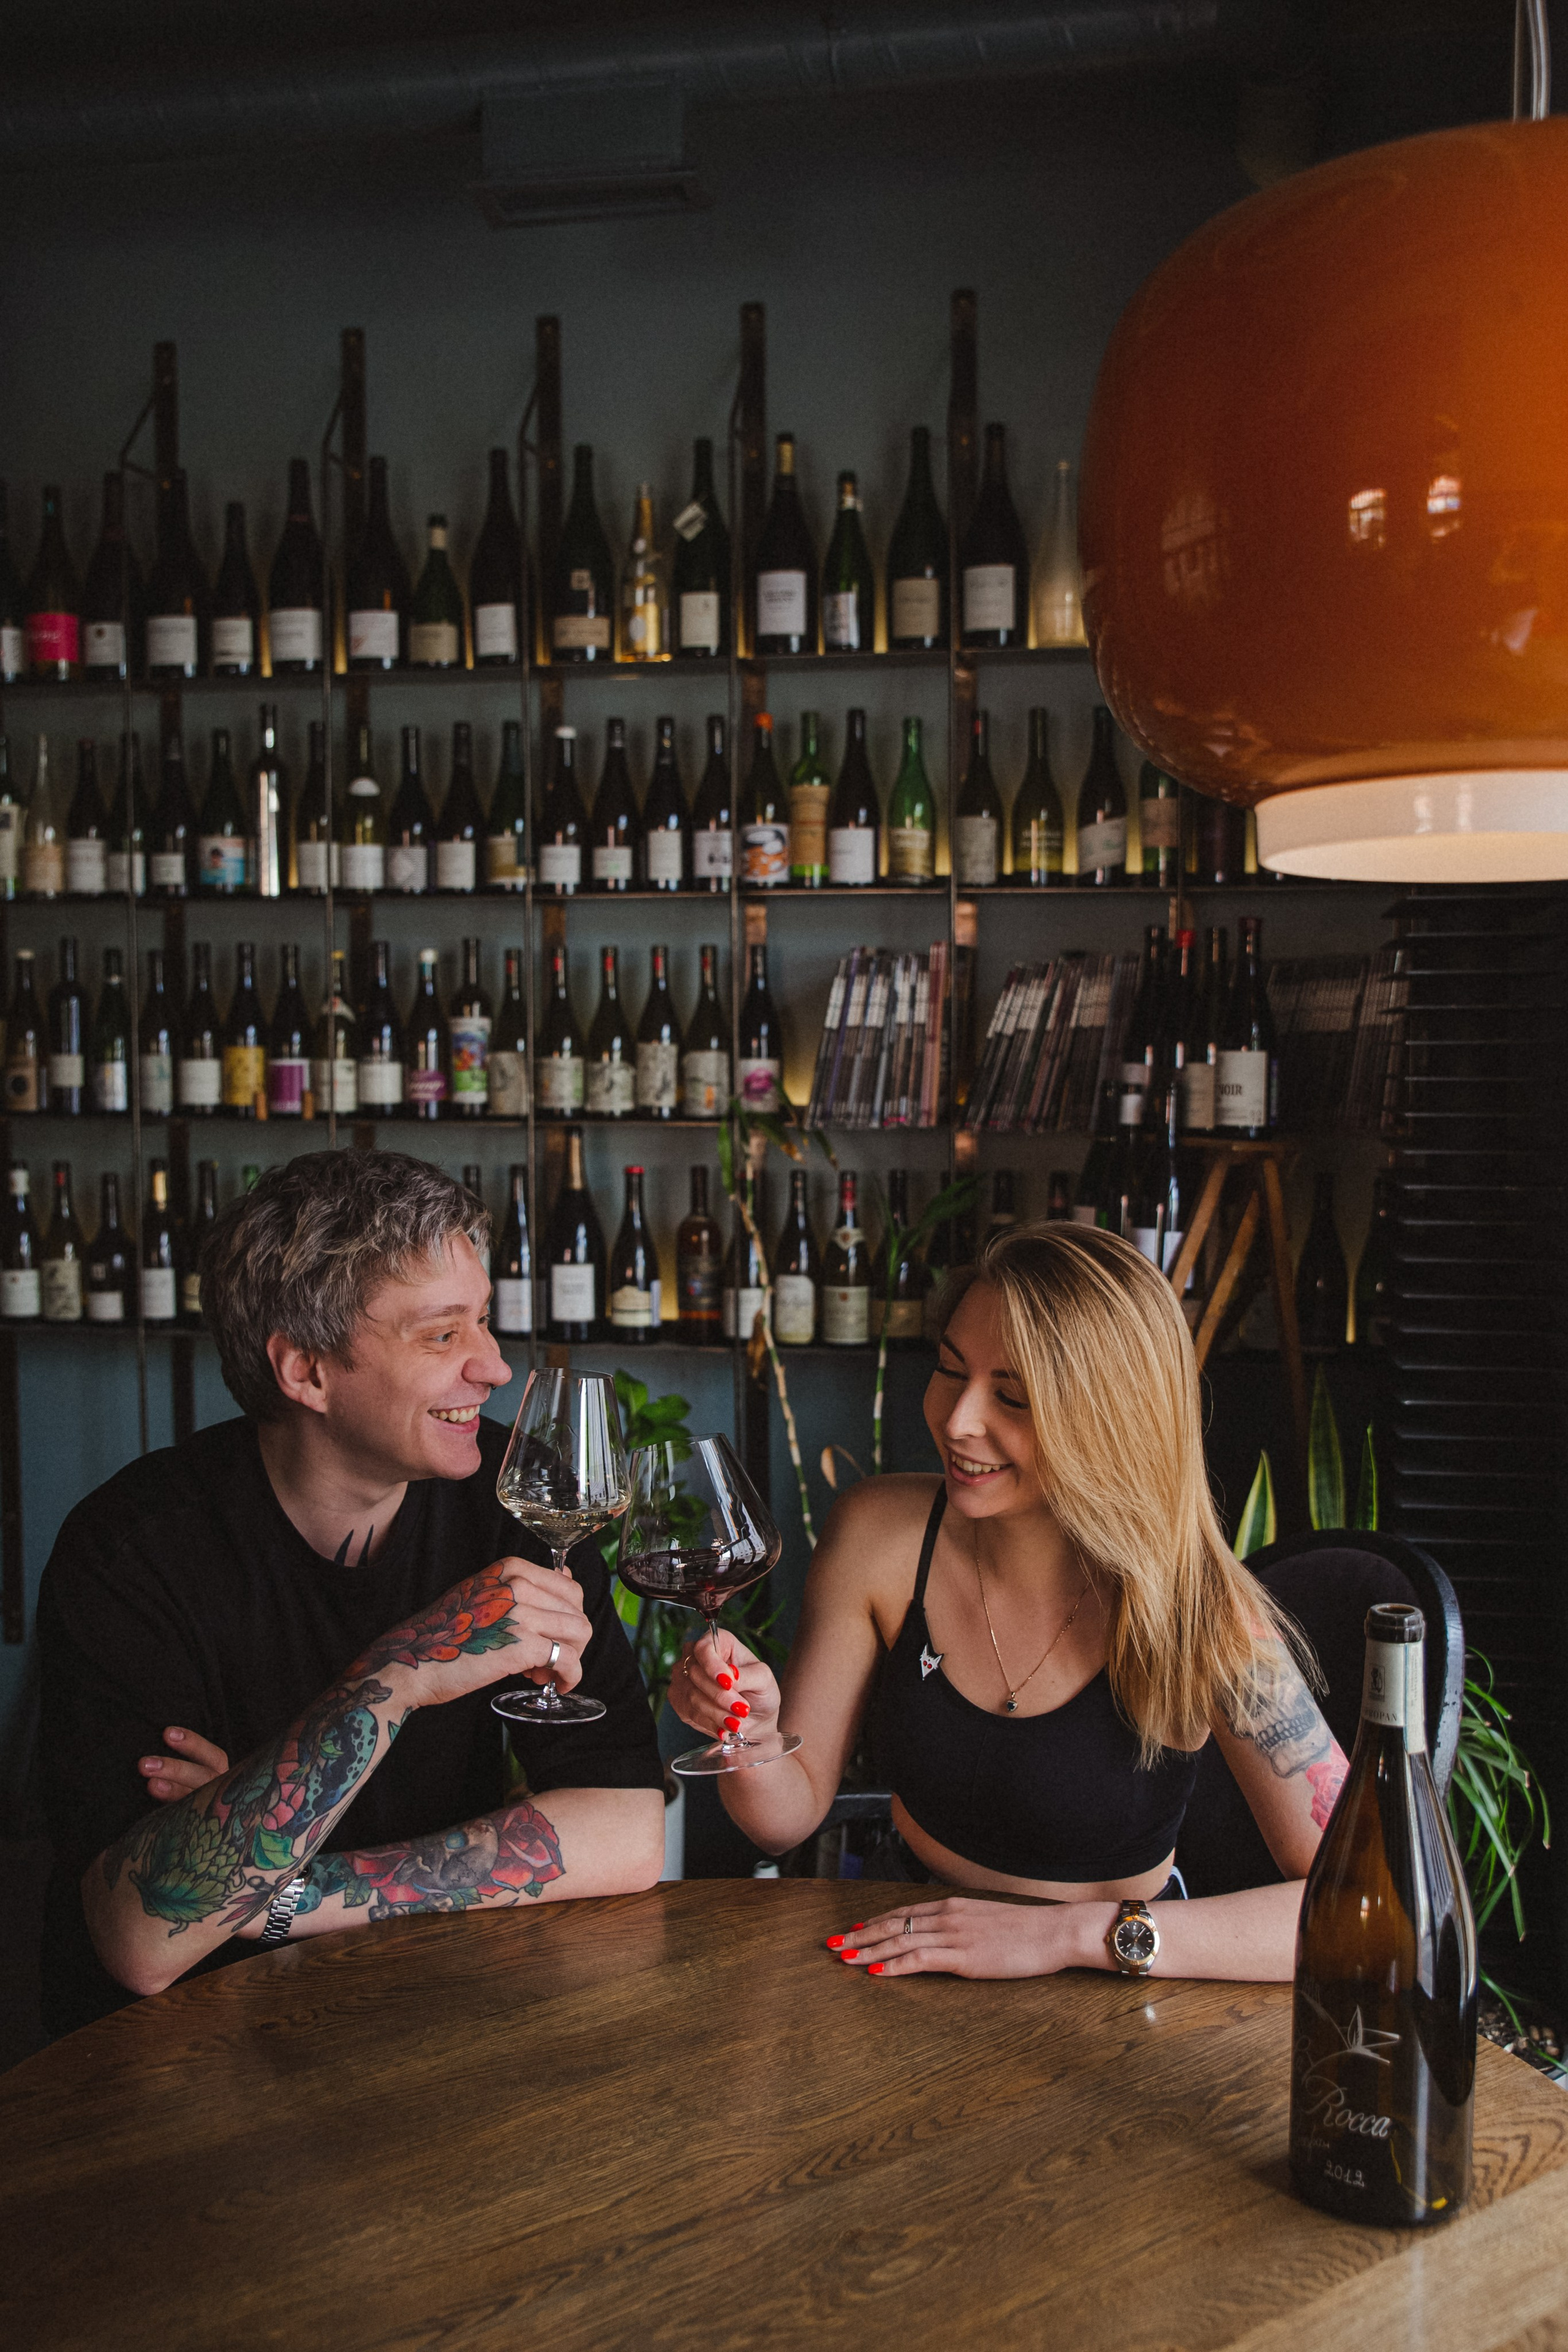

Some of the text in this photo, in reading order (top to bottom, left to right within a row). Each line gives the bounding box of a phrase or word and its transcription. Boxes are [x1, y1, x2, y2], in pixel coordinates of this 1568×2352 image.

[1216, 1084, 1242, 1096] NOIR
[1298, 2075, 1391, 2138] Rocca
[1324, 2160, 1365, 2188] 2012
